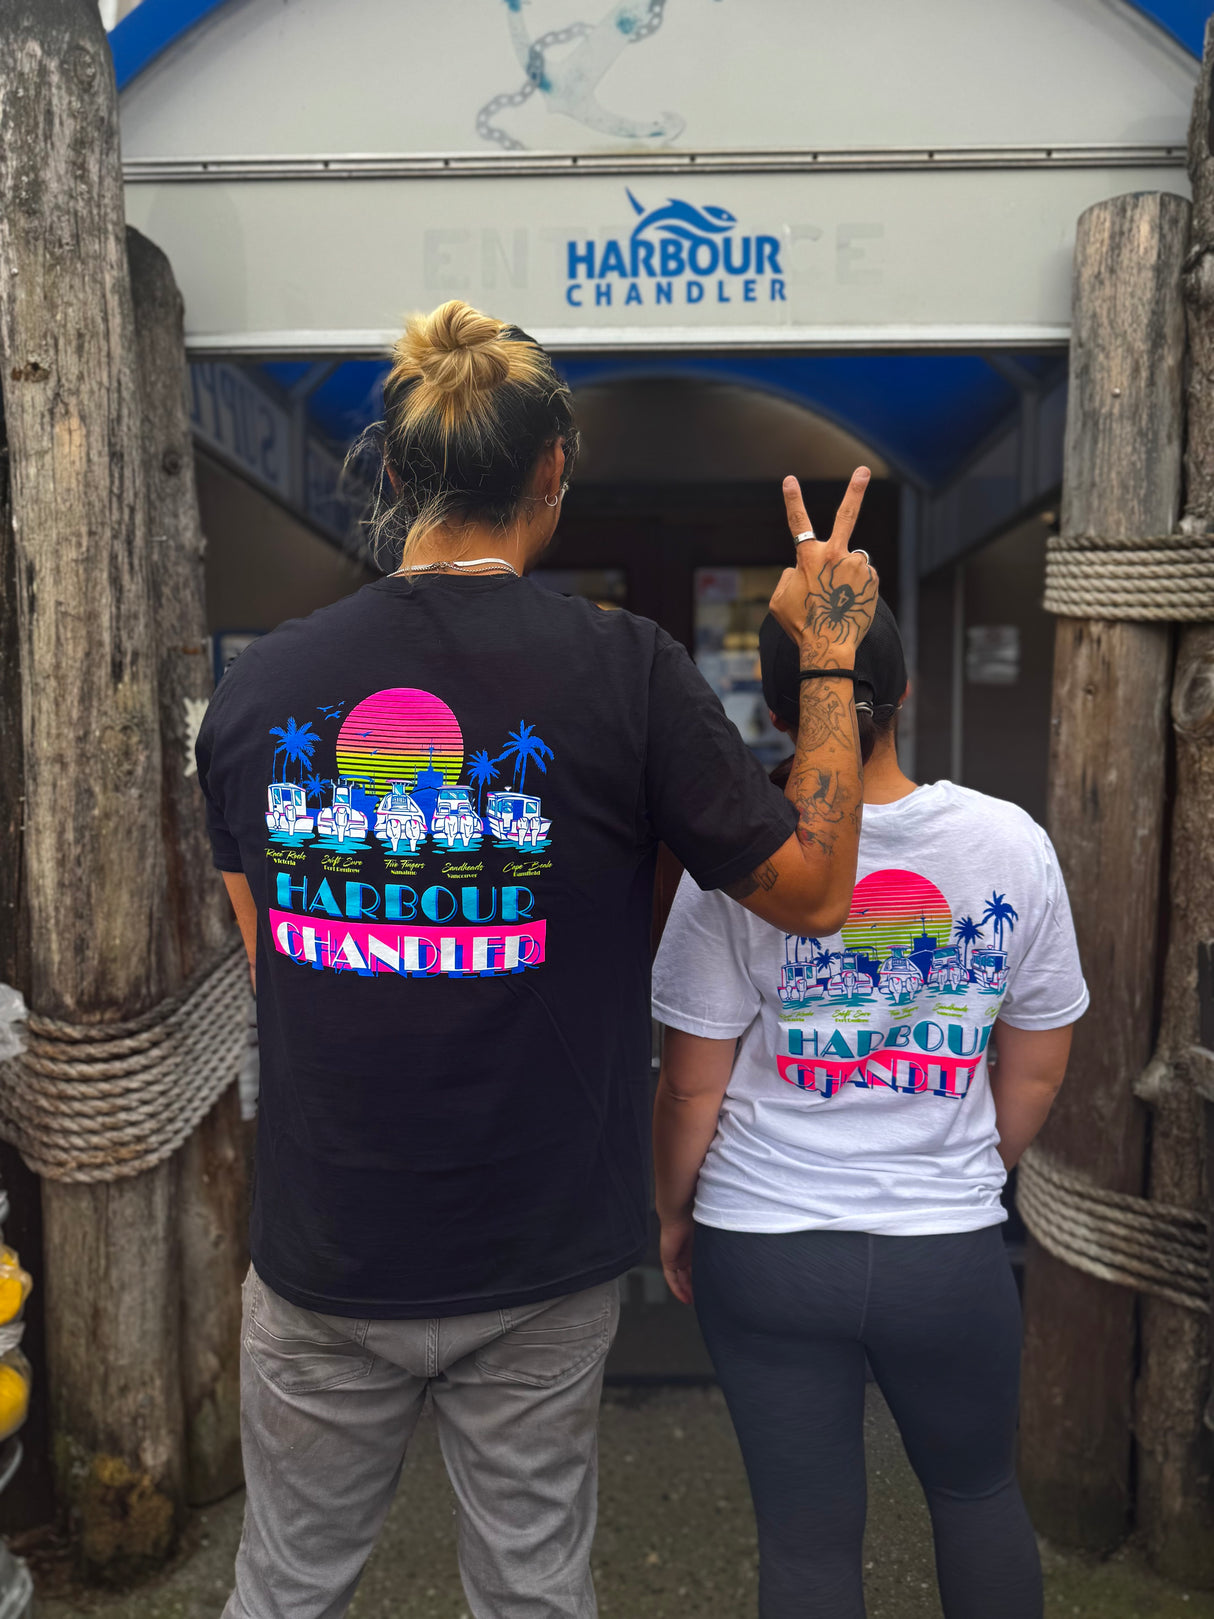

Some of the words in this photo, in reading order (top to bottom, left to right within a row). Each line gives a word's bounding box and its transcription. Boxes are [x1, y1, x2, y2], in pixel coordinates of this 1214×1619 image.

[567, 235, 784, 281] HARBOUR
[566, 279, 787, 307] CHANDLER
[276, 872, 535, 923] HARBOUR
[276, 921, 541, 978] CHANDLER
